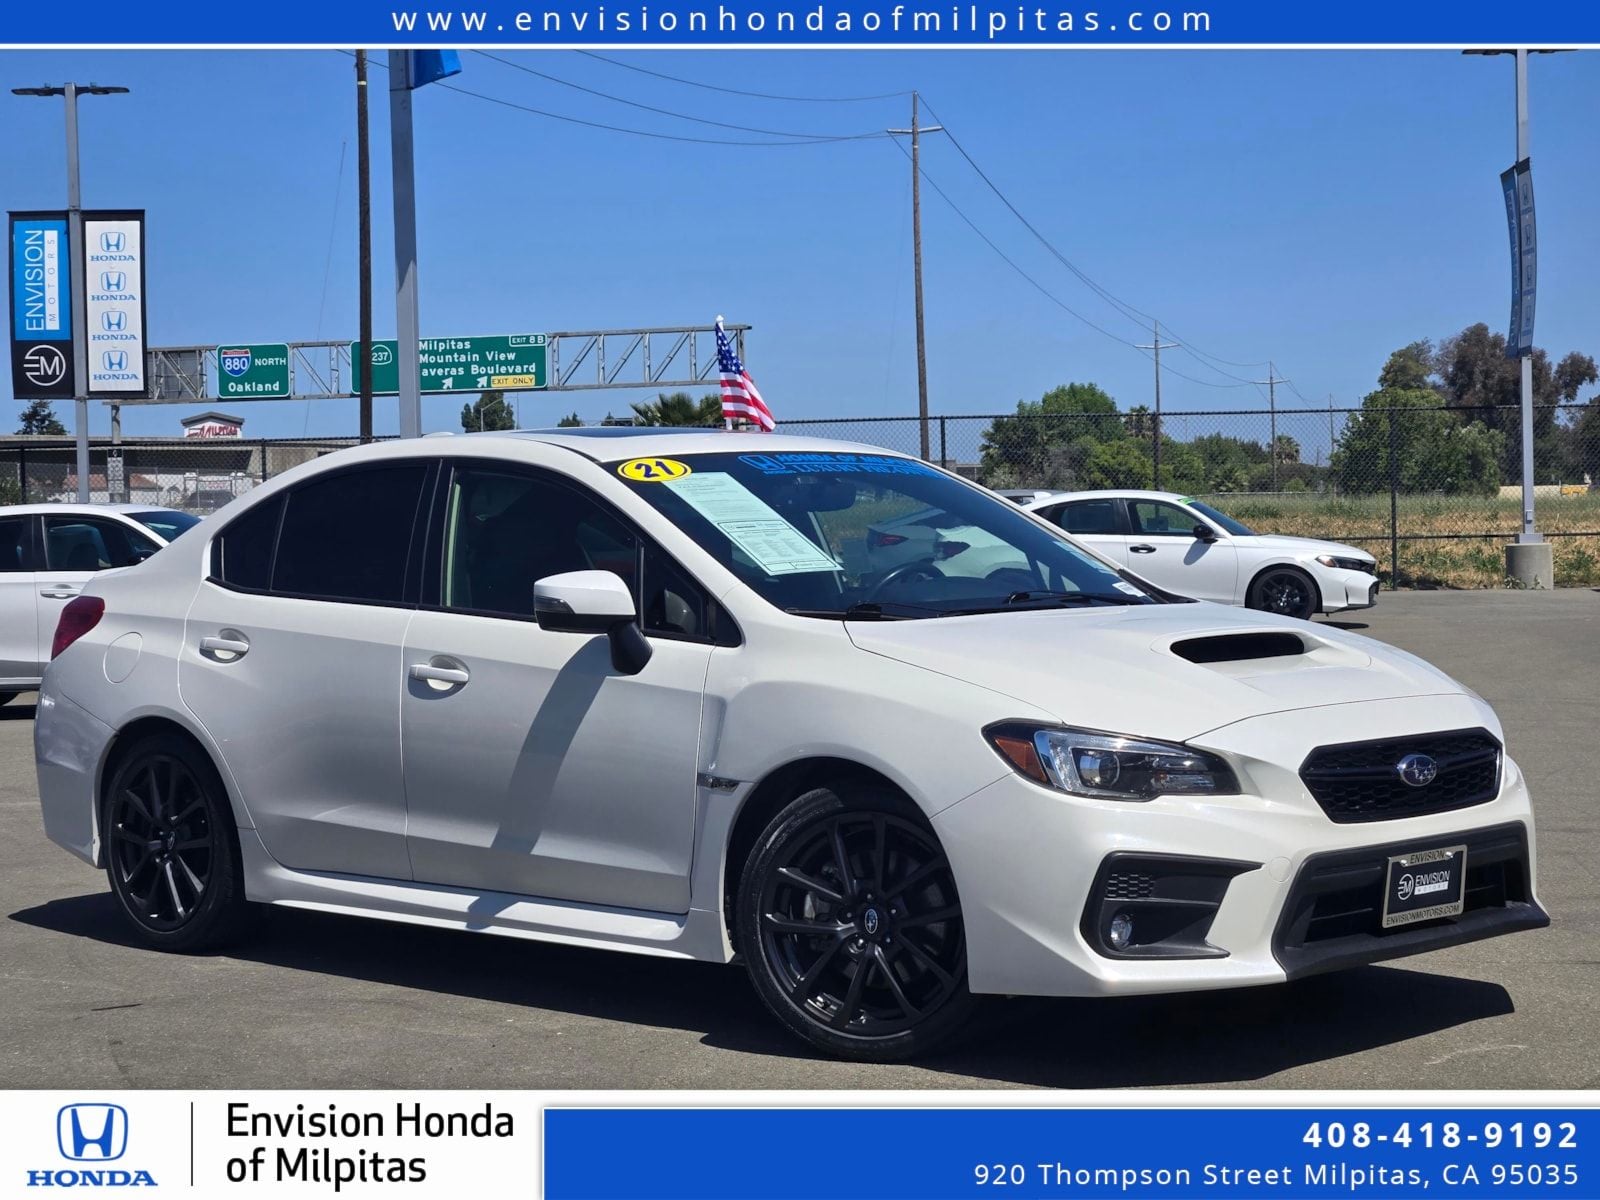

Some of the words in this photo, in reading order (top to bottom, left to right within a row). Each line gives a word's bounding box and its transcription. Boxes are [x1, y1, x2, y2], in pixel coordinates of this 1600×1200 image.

[25, 230, 44, 331] ENVISION
[47, 239, 57, 322] MOTORS
[418, 340, 471, 353] Milpitas
[371, 352, 388, 361] 237
[419, 352, 480, 363] Mountain
[486, 351, 516, 361] View
[225, 357, 248, 371] 880
[255, 358, 287, 366] NORTH
[421, 366, 465, 377] averas
[471, 362, 536, 375] Boulevard
[228, 381, 280, 393] Oakland
[512, 377, 534, 385] ONLY
[634, 461, 675, 478] 21
[1410, 850, 1446, 864] ENVISION
[1415, 870, 1451, 886] ENVISION
[1386, 904, 1460, 926] ENVISIONMOTORS.COM
